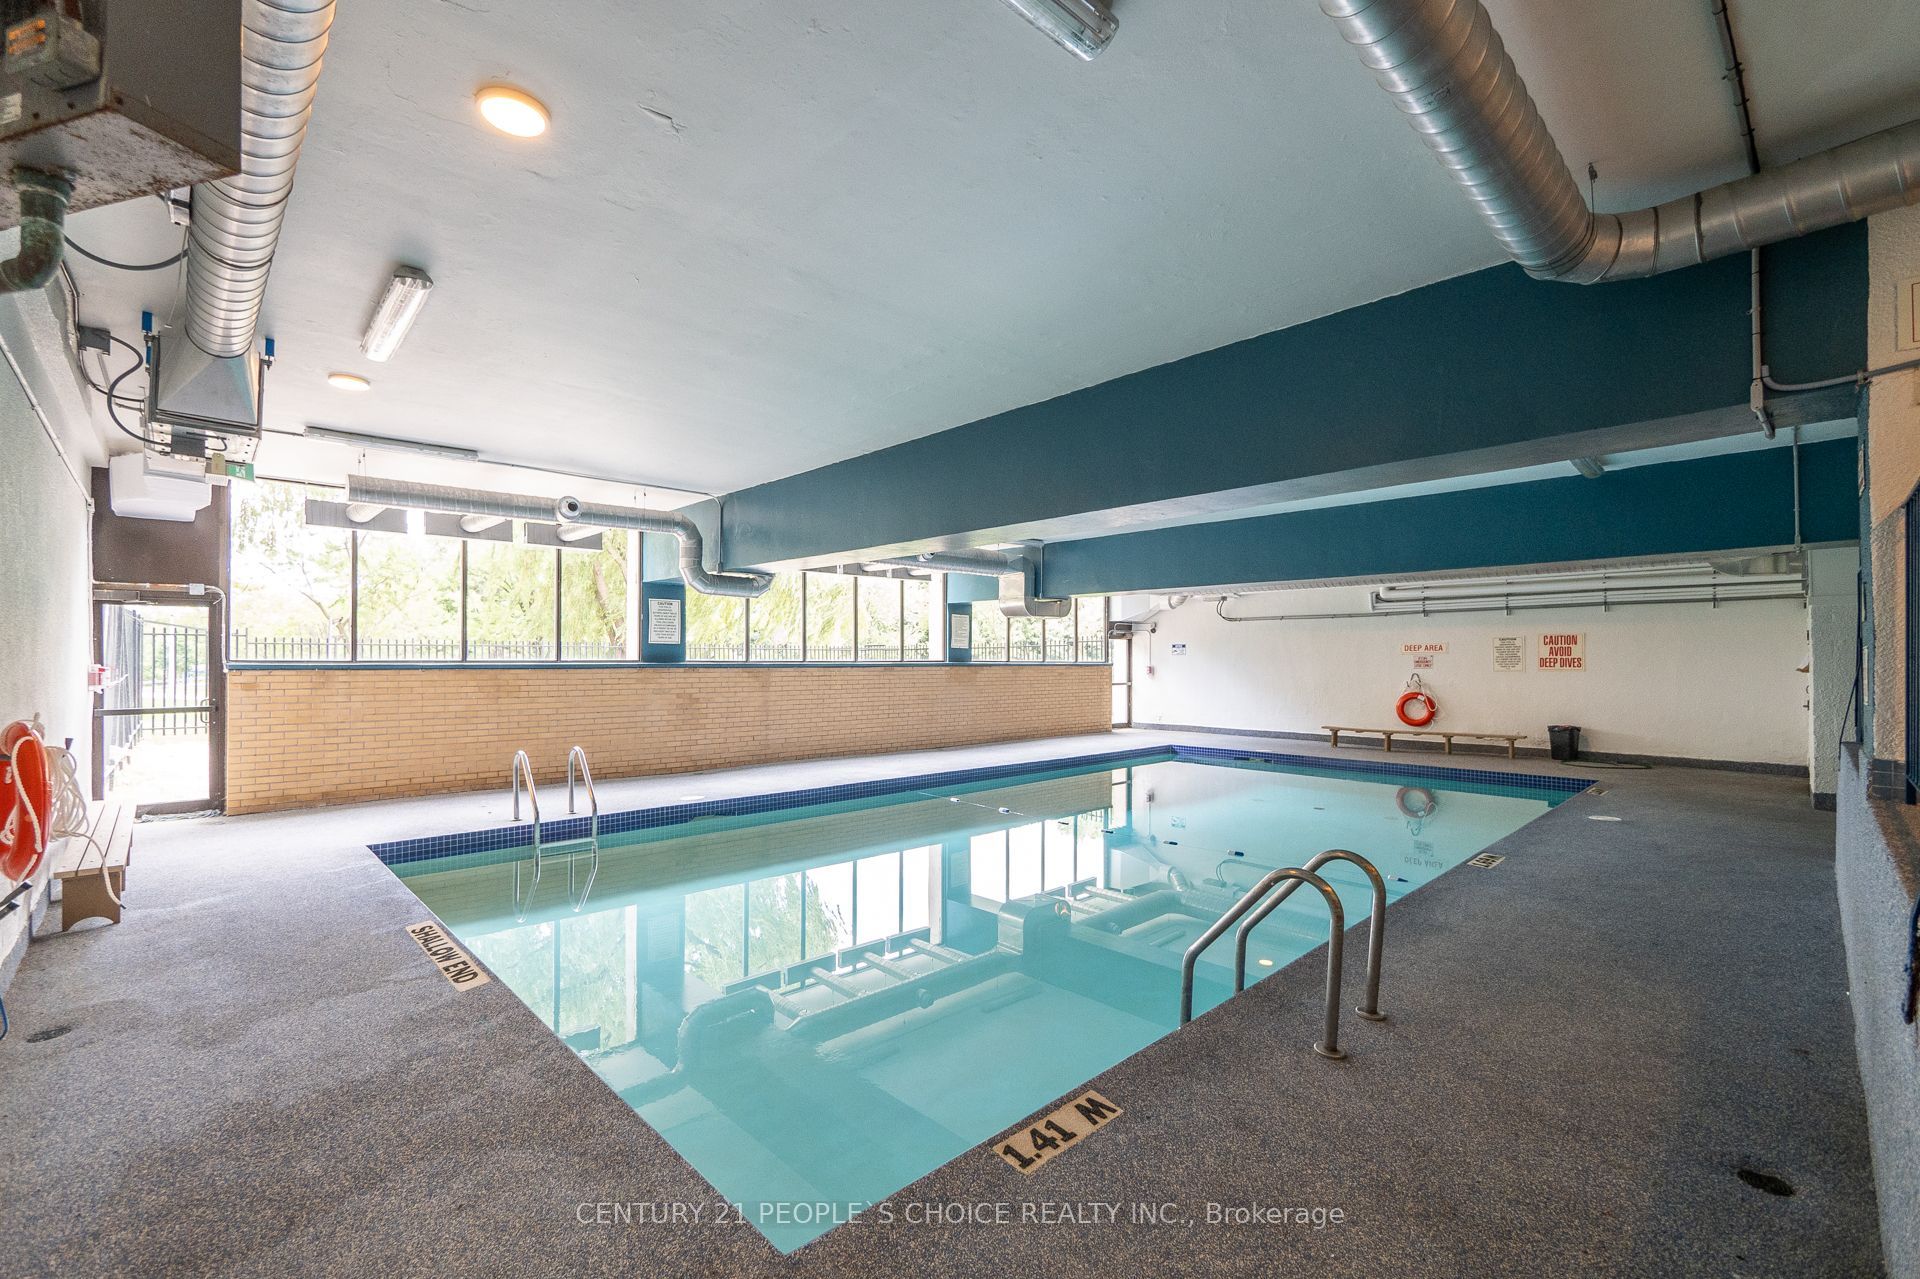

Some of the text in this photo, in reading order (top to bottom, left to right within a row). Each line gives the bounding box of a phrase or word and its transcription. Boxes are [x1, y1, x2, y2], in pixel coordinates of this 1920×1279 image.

[1543, 634, 1577, 646] CAUTION
[1549, 646, 1572, 656] AVOID
[1540, 657, 1582, 668] DEEP DIVES
[411, 925, 478, 984] SHALLOW END
[1002, 1097, 1117, 1169] 1.41 M
